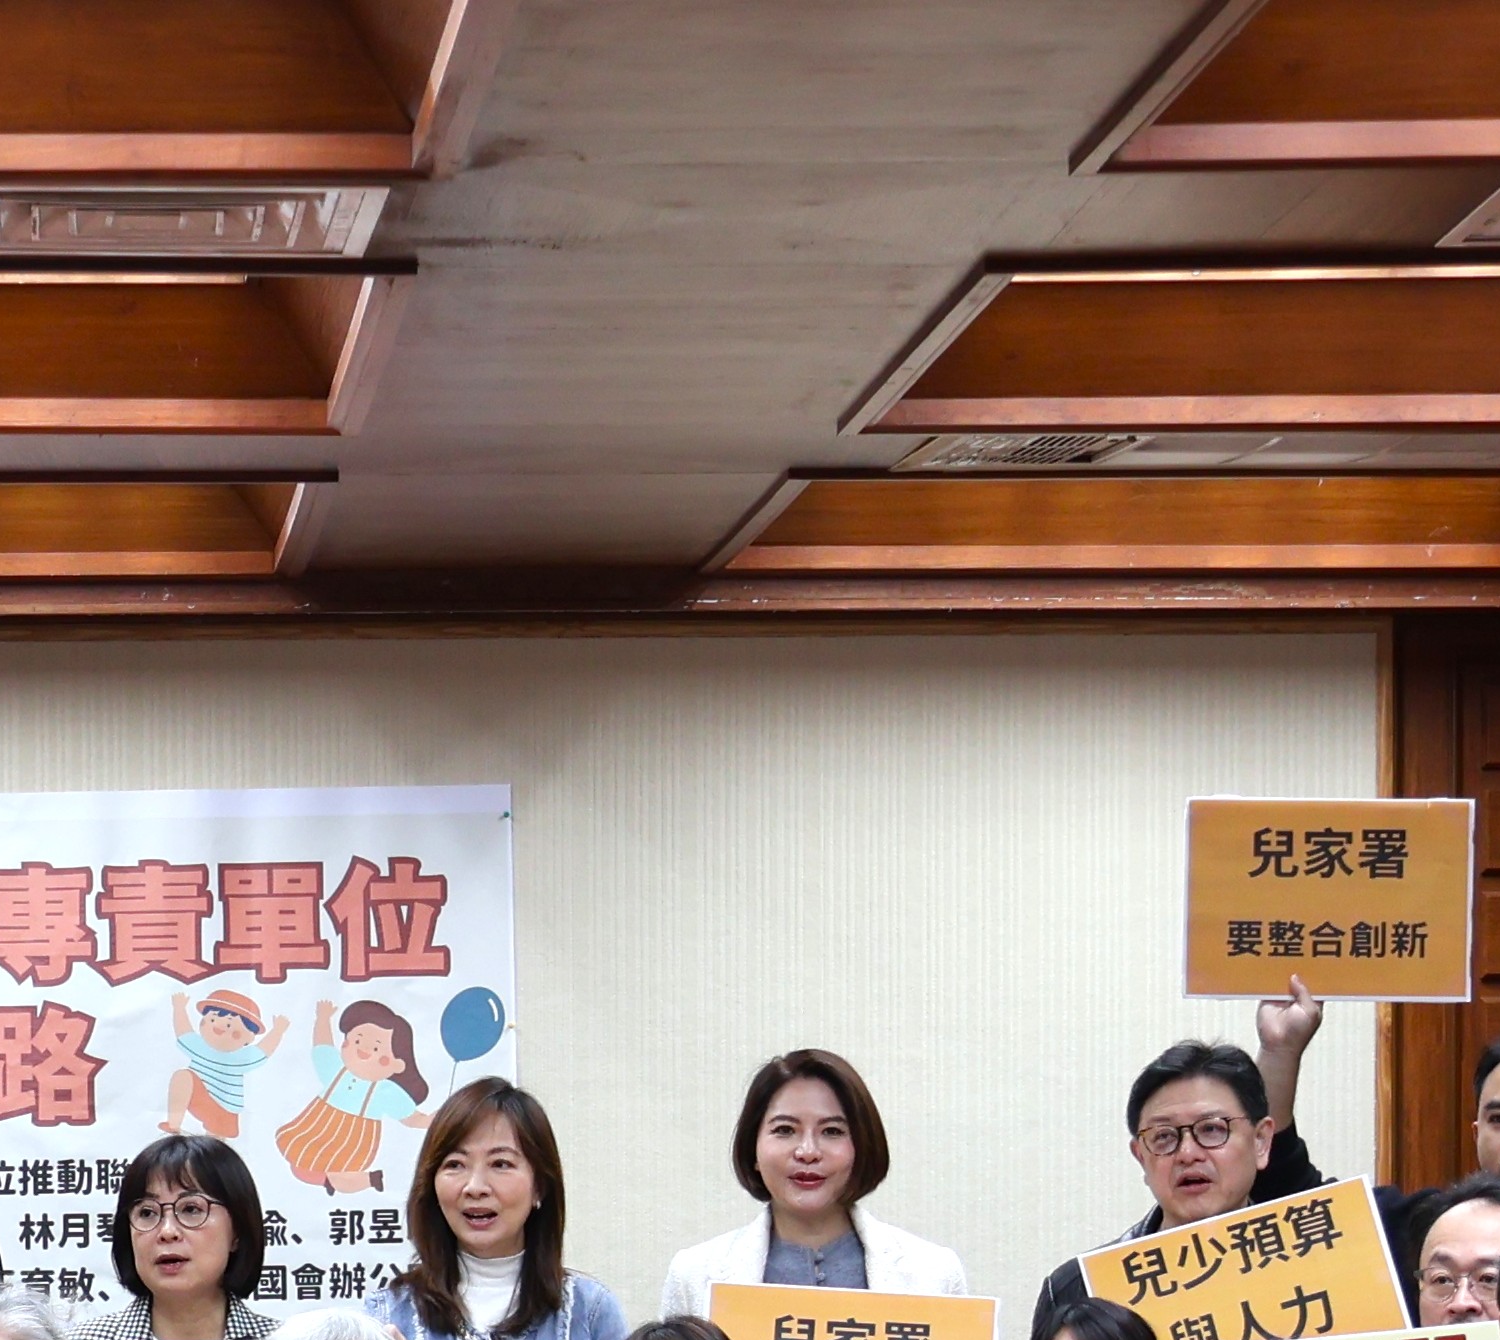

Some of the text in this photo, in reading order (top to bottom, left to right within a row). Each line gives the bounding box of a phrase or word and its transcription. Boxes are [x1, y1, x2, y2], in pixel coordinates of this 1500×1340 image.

[1248, 827, 1409, 879] 兒家署
[1226, 920, 1428, 958] 要整合創新
[1122, 1198, 1343, 1306] 兒少預算
